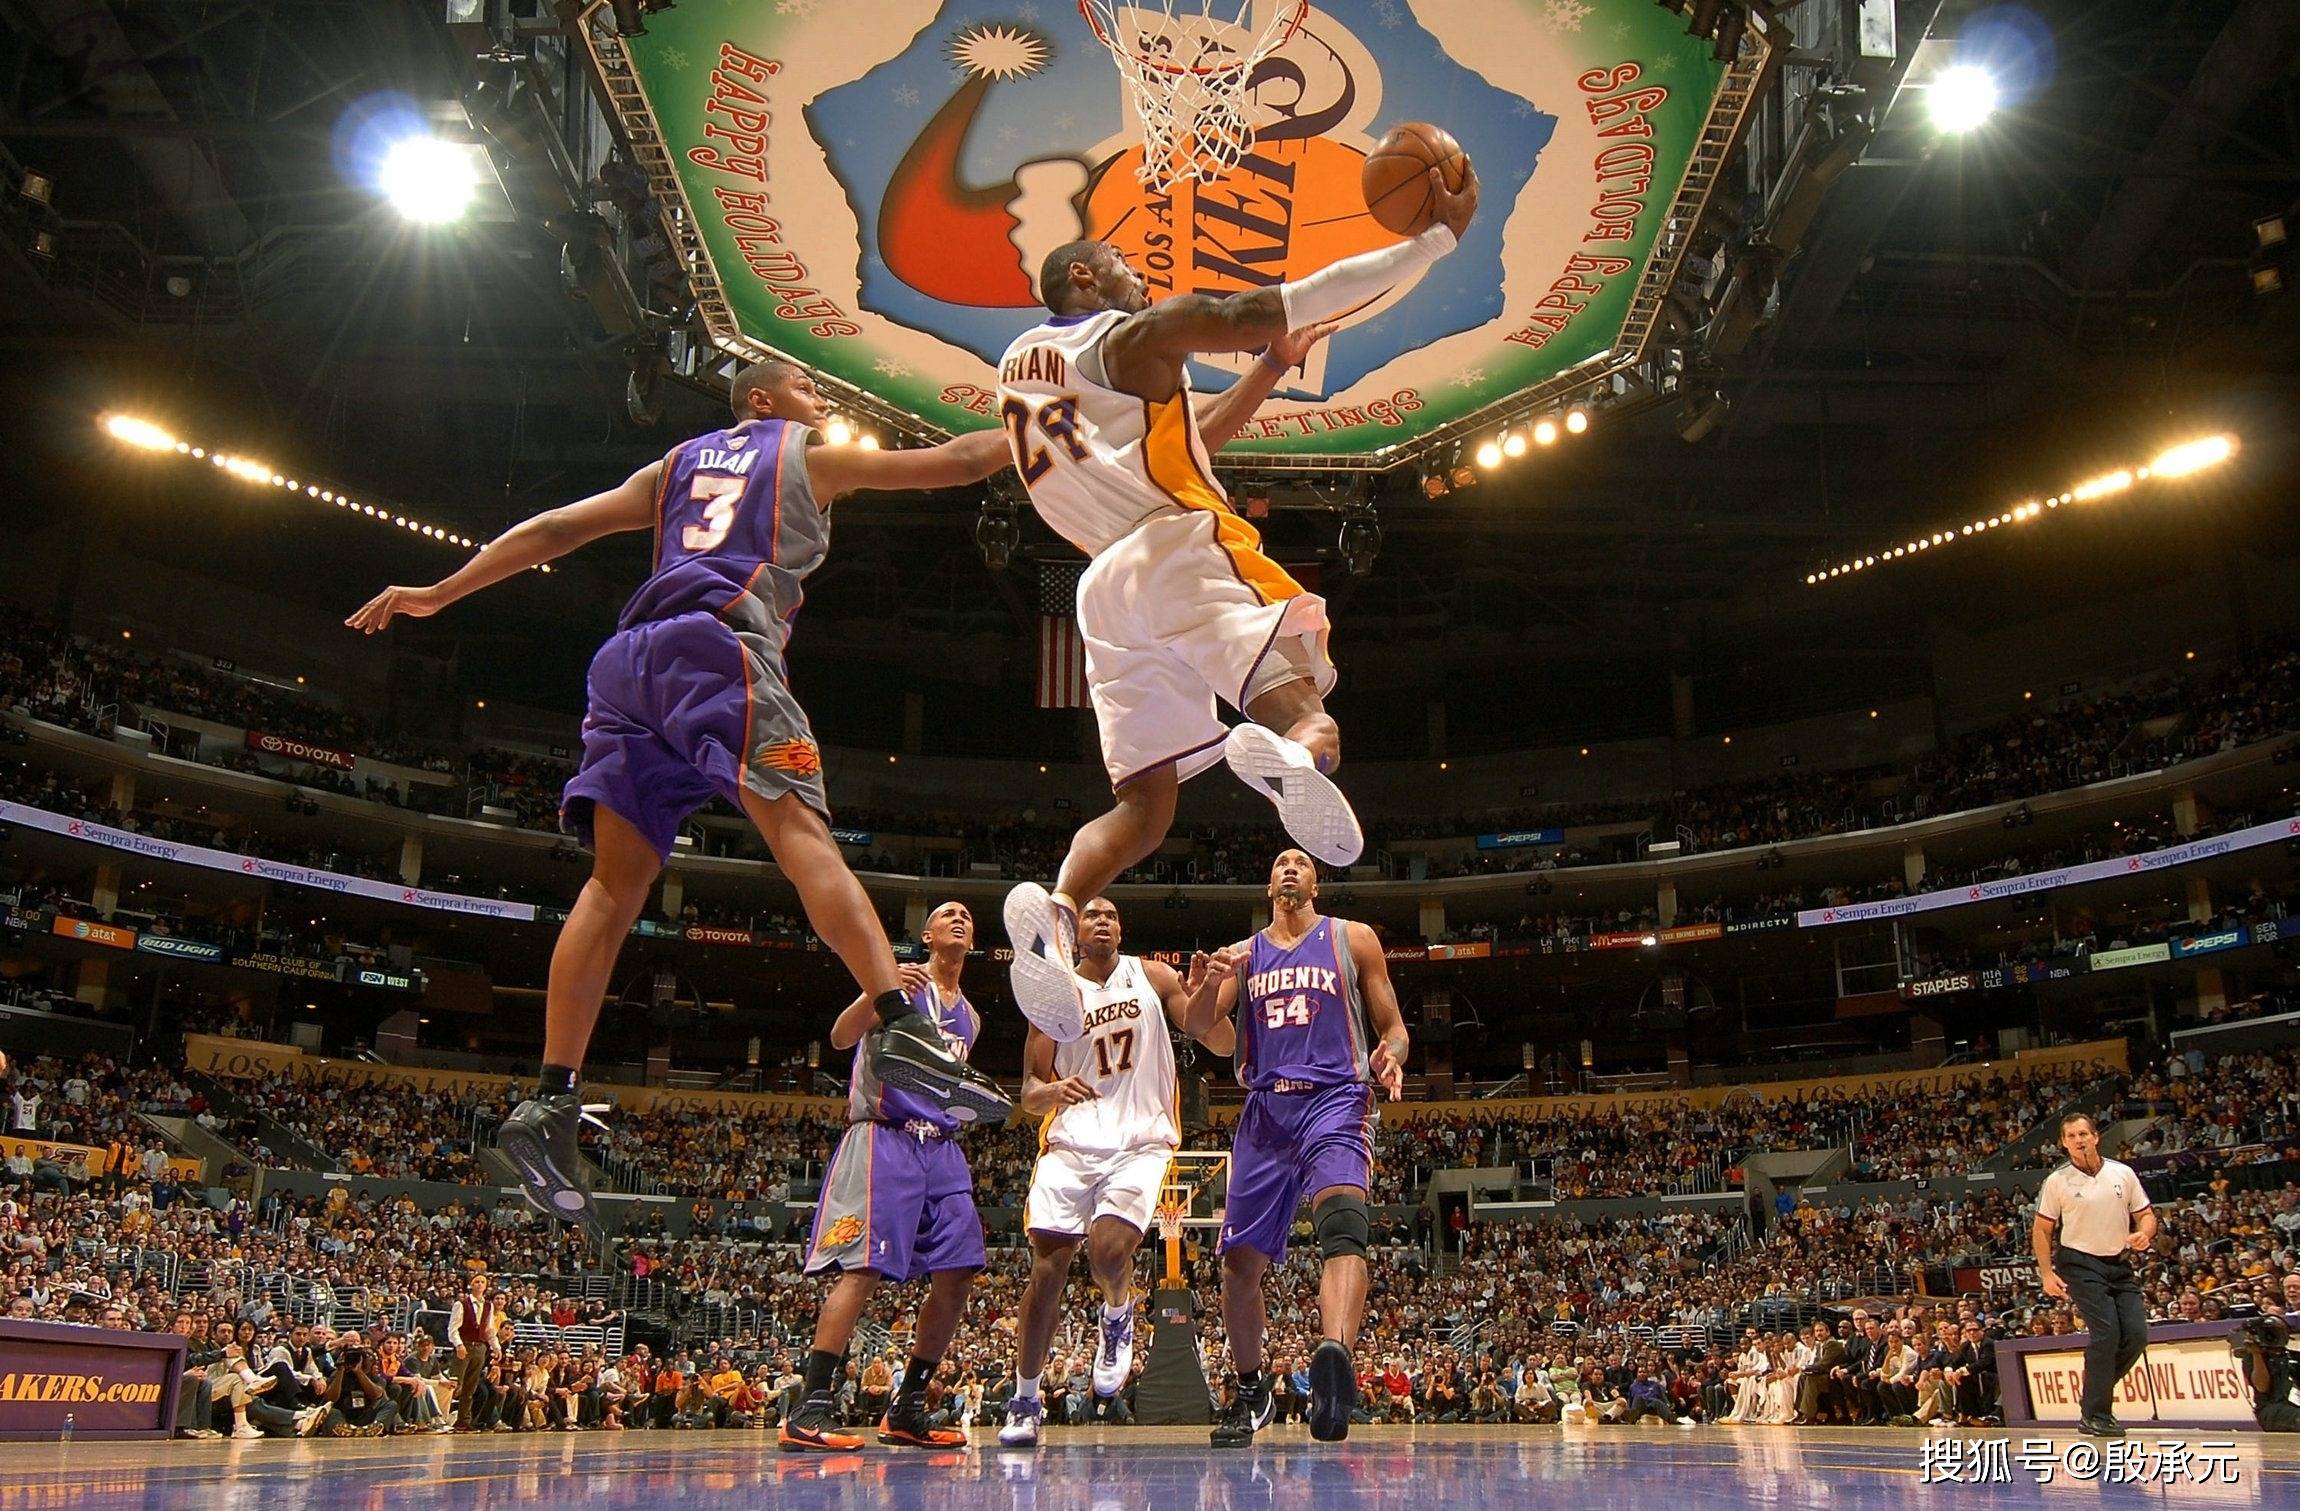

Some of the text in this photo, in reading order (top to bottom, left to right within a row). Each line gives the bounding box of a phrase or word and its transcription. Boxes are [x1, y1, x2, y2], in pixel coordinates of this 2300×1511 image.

[687, 42, 861, 339] HAPPY HOLIDAYS
[1504, 61, 1668, 351] HAPPY HOLIDAYS
[1145, 230, 1174, 290] LOS
[681, 474, 750, 551] 3
[285, 741, 341, 765] TOYOTA
[84, 825, 179, 859] Sempra Energy
[1508, 832, 1542, 843] PEPSI
[2142, 838, 2231, 868] Sempra Energy
[257, 861, 349, 891] Sempra Energy
[1982, 872, 2069, 897] Sempra Energy
[417, 891, 505, 916] Sempra Energy
[1836, 901, 1918, 921] Sempra Energy
[4, 916, 28, 930] NBA
[1697, 927, 1720, 937] DEPOT
[1740, 918, 1790, 932] DIRECTV
[2256, 922, 2277, 933] SEA
[91, 929, 117, 942] at&t
[706, 930, 750, 943] TOYOTA
[2195, 933, 2238, 949] PEPSI
[2257, 932, 2279, 943] POR
[144, 937, 220, 957] BUD LIGHT
[251, 953, 277, 963] AUTO
[2104, 950, 2165, 966] Sempra Energy
[232, 958, 335, 980] SOUTHERN CALIFORNIA
[1983, 969, 2002, 979] MIA
[1984, 978, 2003, 988] CLE
[2050, 969, 2070, 978] NBA
[387, 976, 409, 987] WEST
[1247, 966, 1336, 1002] PHOENIX
[1912, 976, 1970, 996] STAPLES
[1084, 998, 1141, 1034] AKERS
[1265, 994, 1309, 1030] 54
[1094, 1027, 1134, 1079] 17
[206, 1052, 270, 1078] LOS
[1795, 1082, 1847, 1101] LOS
[650, 1096, 703, 1114] LOS
[1410, 1107, 1463, 1124] LOS
[0, 1373, 161, 1403] AKERS.com
[2033, 1371, 2067, 1404] THE
[2122, 1363, 2185, 1403] BOWL
[2189, 1369, 2239, 1399] LIVES
